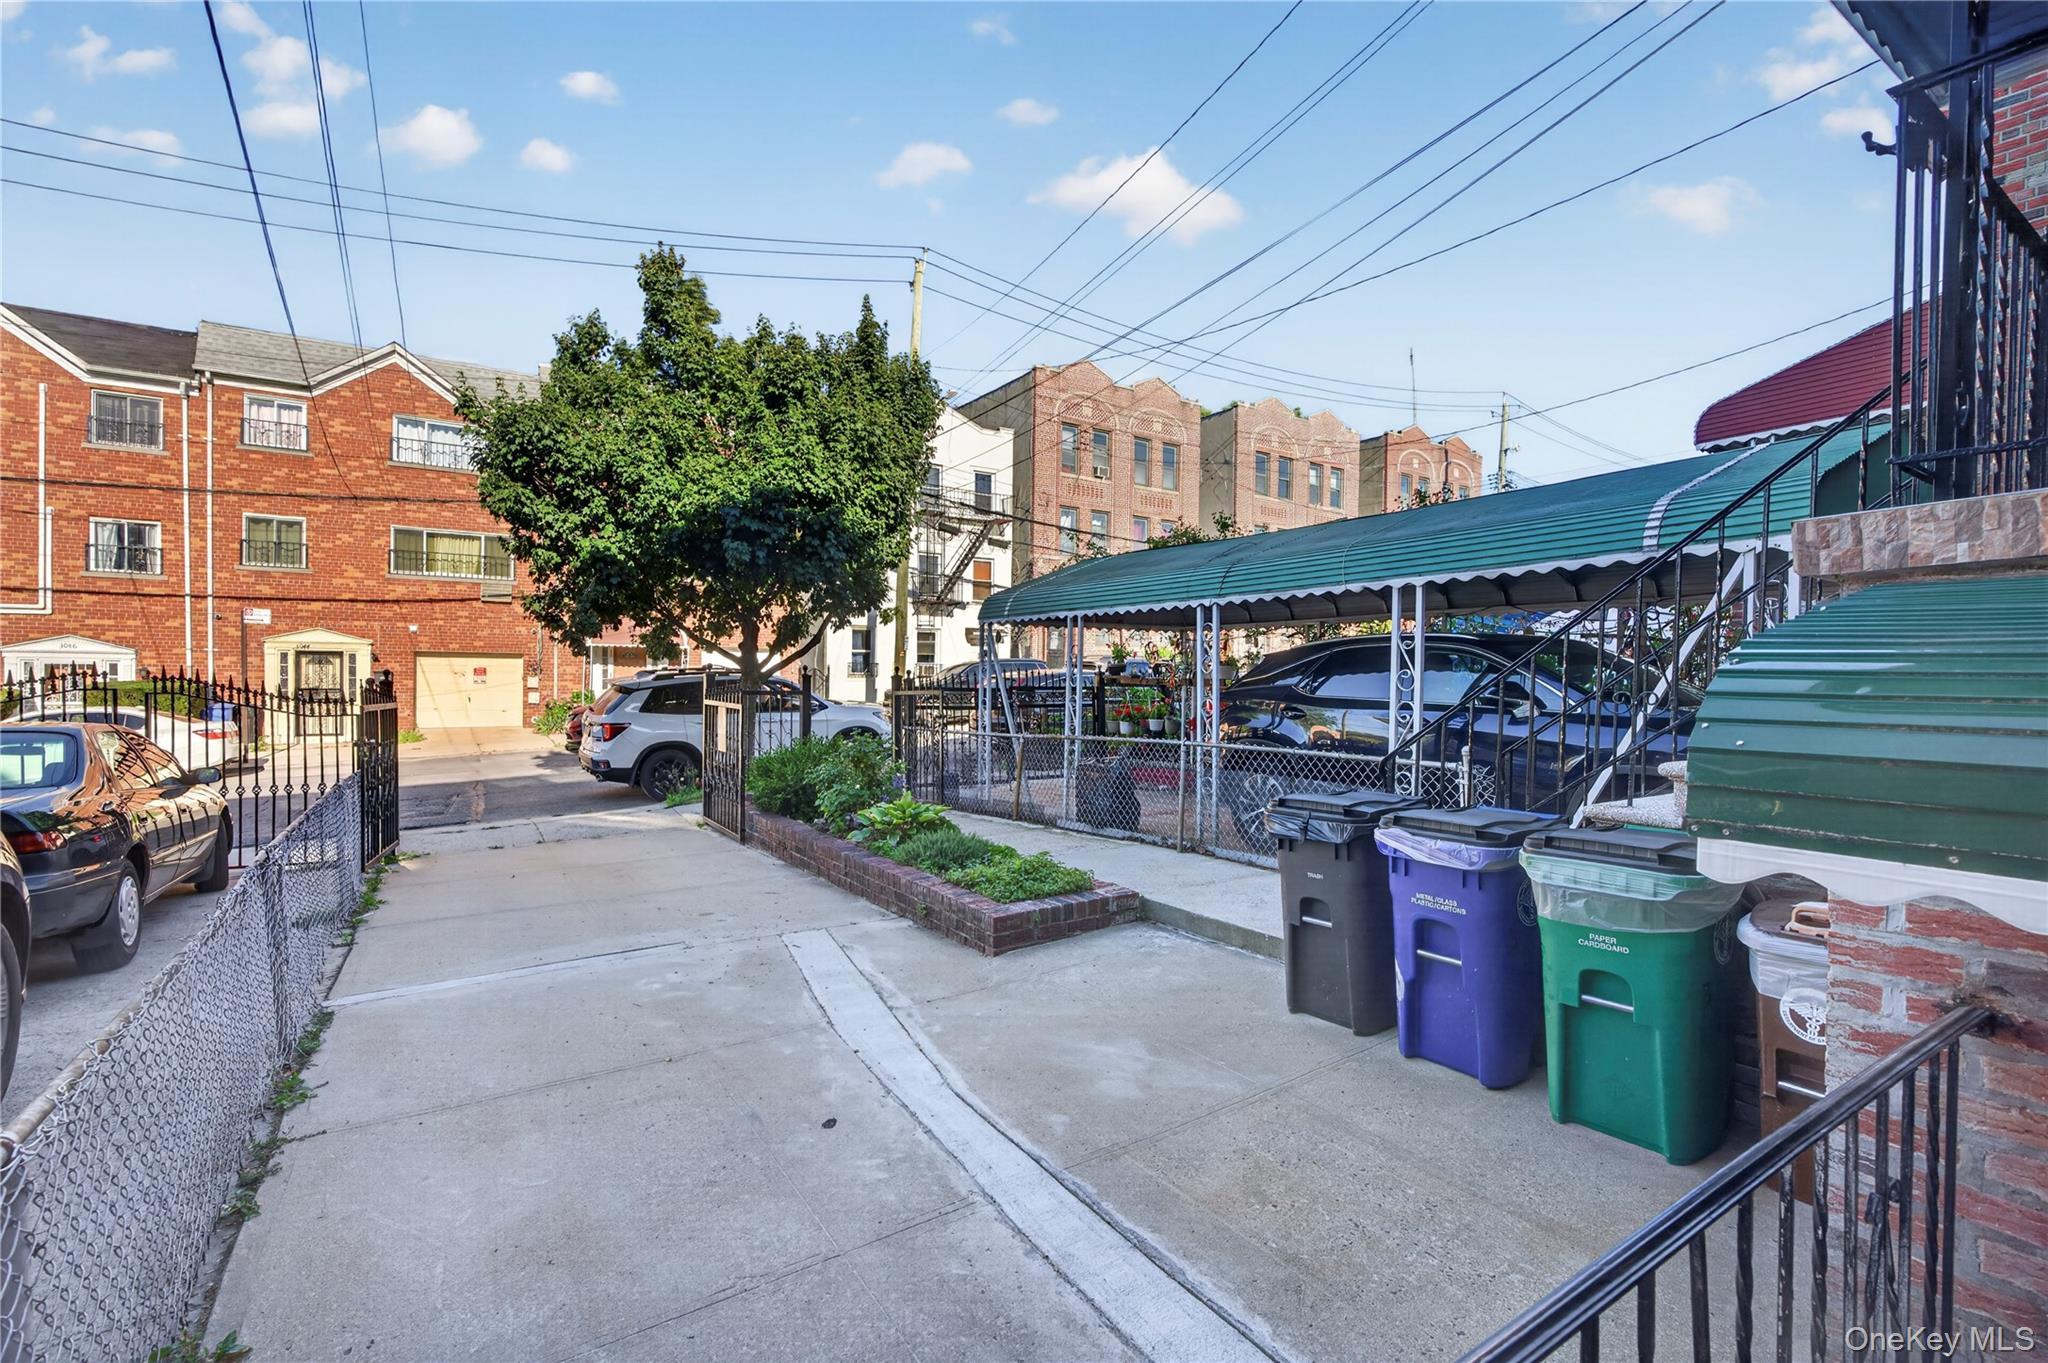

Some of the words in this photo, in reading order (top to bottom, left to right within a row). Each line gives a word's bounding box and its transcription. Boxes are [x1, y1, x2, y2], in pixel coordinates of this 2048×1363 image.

[1410, 897, 1467, 915] PLASTIC/CARTONS
[1415, 892, 1458, 907] METAL/GLASS
[1578, 938, 1630, 954] CARDBOARD
[1589, 933, 1617, 945] PAPER
